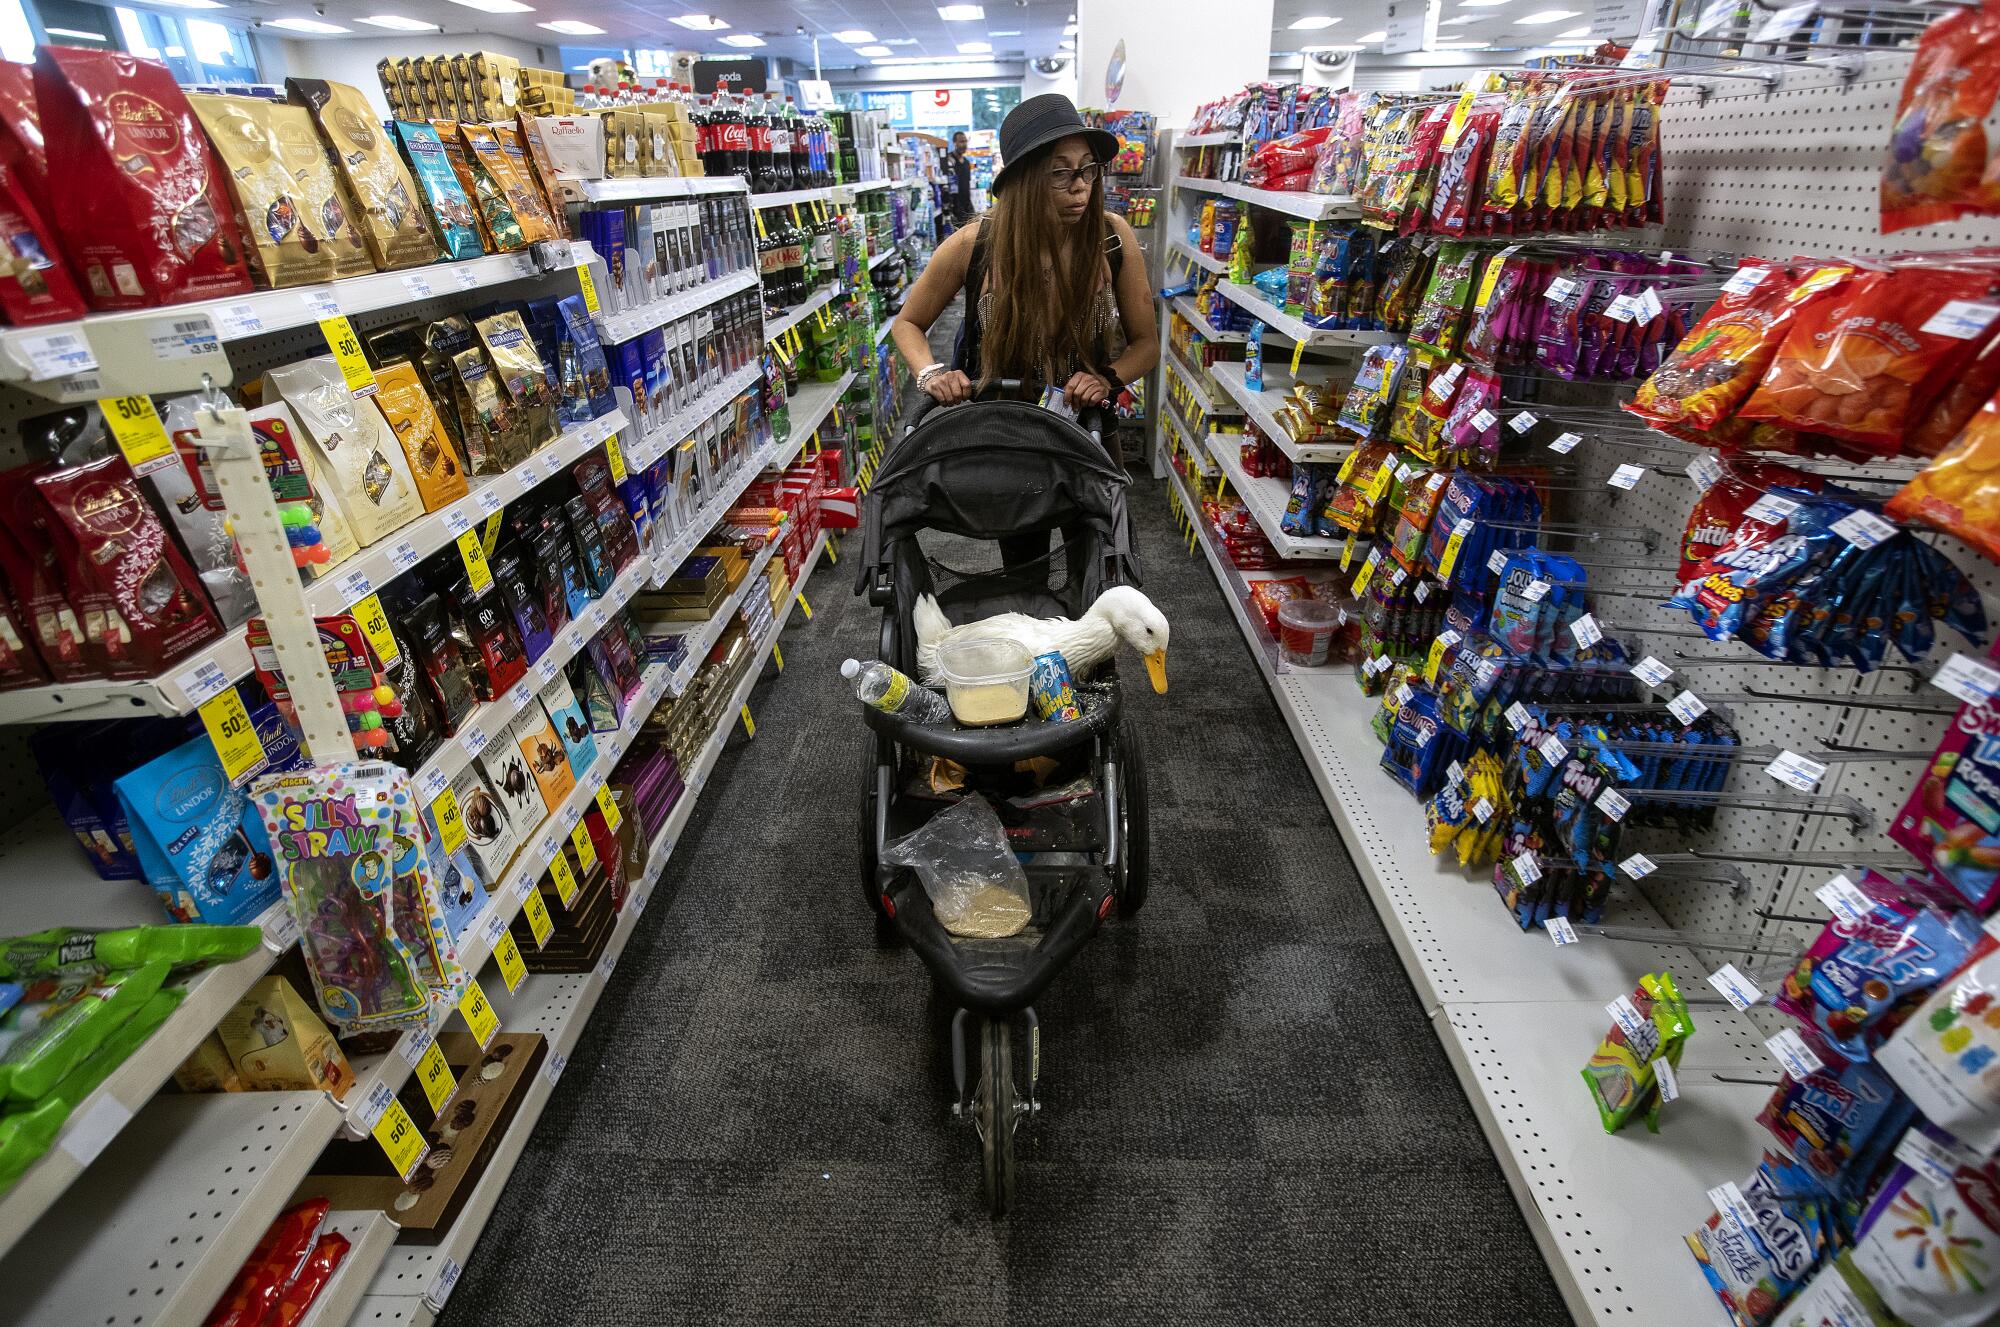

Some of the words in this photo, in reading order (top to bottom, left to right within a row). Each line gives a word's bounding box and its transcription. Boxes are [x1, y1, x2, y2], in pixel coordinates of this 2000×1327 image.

[719, 71, 742, 82] soda
[127, 127, 169, 139] LINDOR
[552, 126, 585, 135] Raffaello
[434, 332, 471, 348] GHIRARDELLI
[489, 330, 523, 345] GHIRARDELLI
[1879, 320, 1922, 351] slices
[462, 364, 488, 379] GHIRARDELLI
[323, 406, 348, 422] LINDOR
[287, 459, 299, 467] 12
[94, 506, 132, 525] LINDOR
[496, 557, 520, 578] GHIRARDELLI
[1703, 572, 1744, 602] bites
[368, 615, 384, 635] 50%
[353, 655, 366, 663] 12
[223, 698, 234, 707] buy
[228, 706, 238, 715] get
[221, 711, 246, 739] 50%
[262, 722, 284, 746] Lindt
[483, 729, 509, 758] GODIVA
[280, 777, 312, 788] WACKY!
[1563, 759, 1601, 800] Trolli
[1954, 756, 2000, 800] Rope
[174, 786, 215, 816] LINDOR
[285, 794, 359, 832] SILLY
[443, 805, 458, 825] 50%
[169, 842, 183, 855] SEA
[182, 827, 198, 844] SALT
[278, 826, 377, 859] STRAW
[503, 946, 515, 966] 50%
[1821, 960, 1859, 997] Chewy
[470, 996, 484, 1018] 50%
[428, 1058, 443, 1083] 50%
[390, 1116, 408, 1144] 50%
[1713, 1232, 1754, 1285] Snacks
[1718, 1228, 1762, 1272] Fruit
